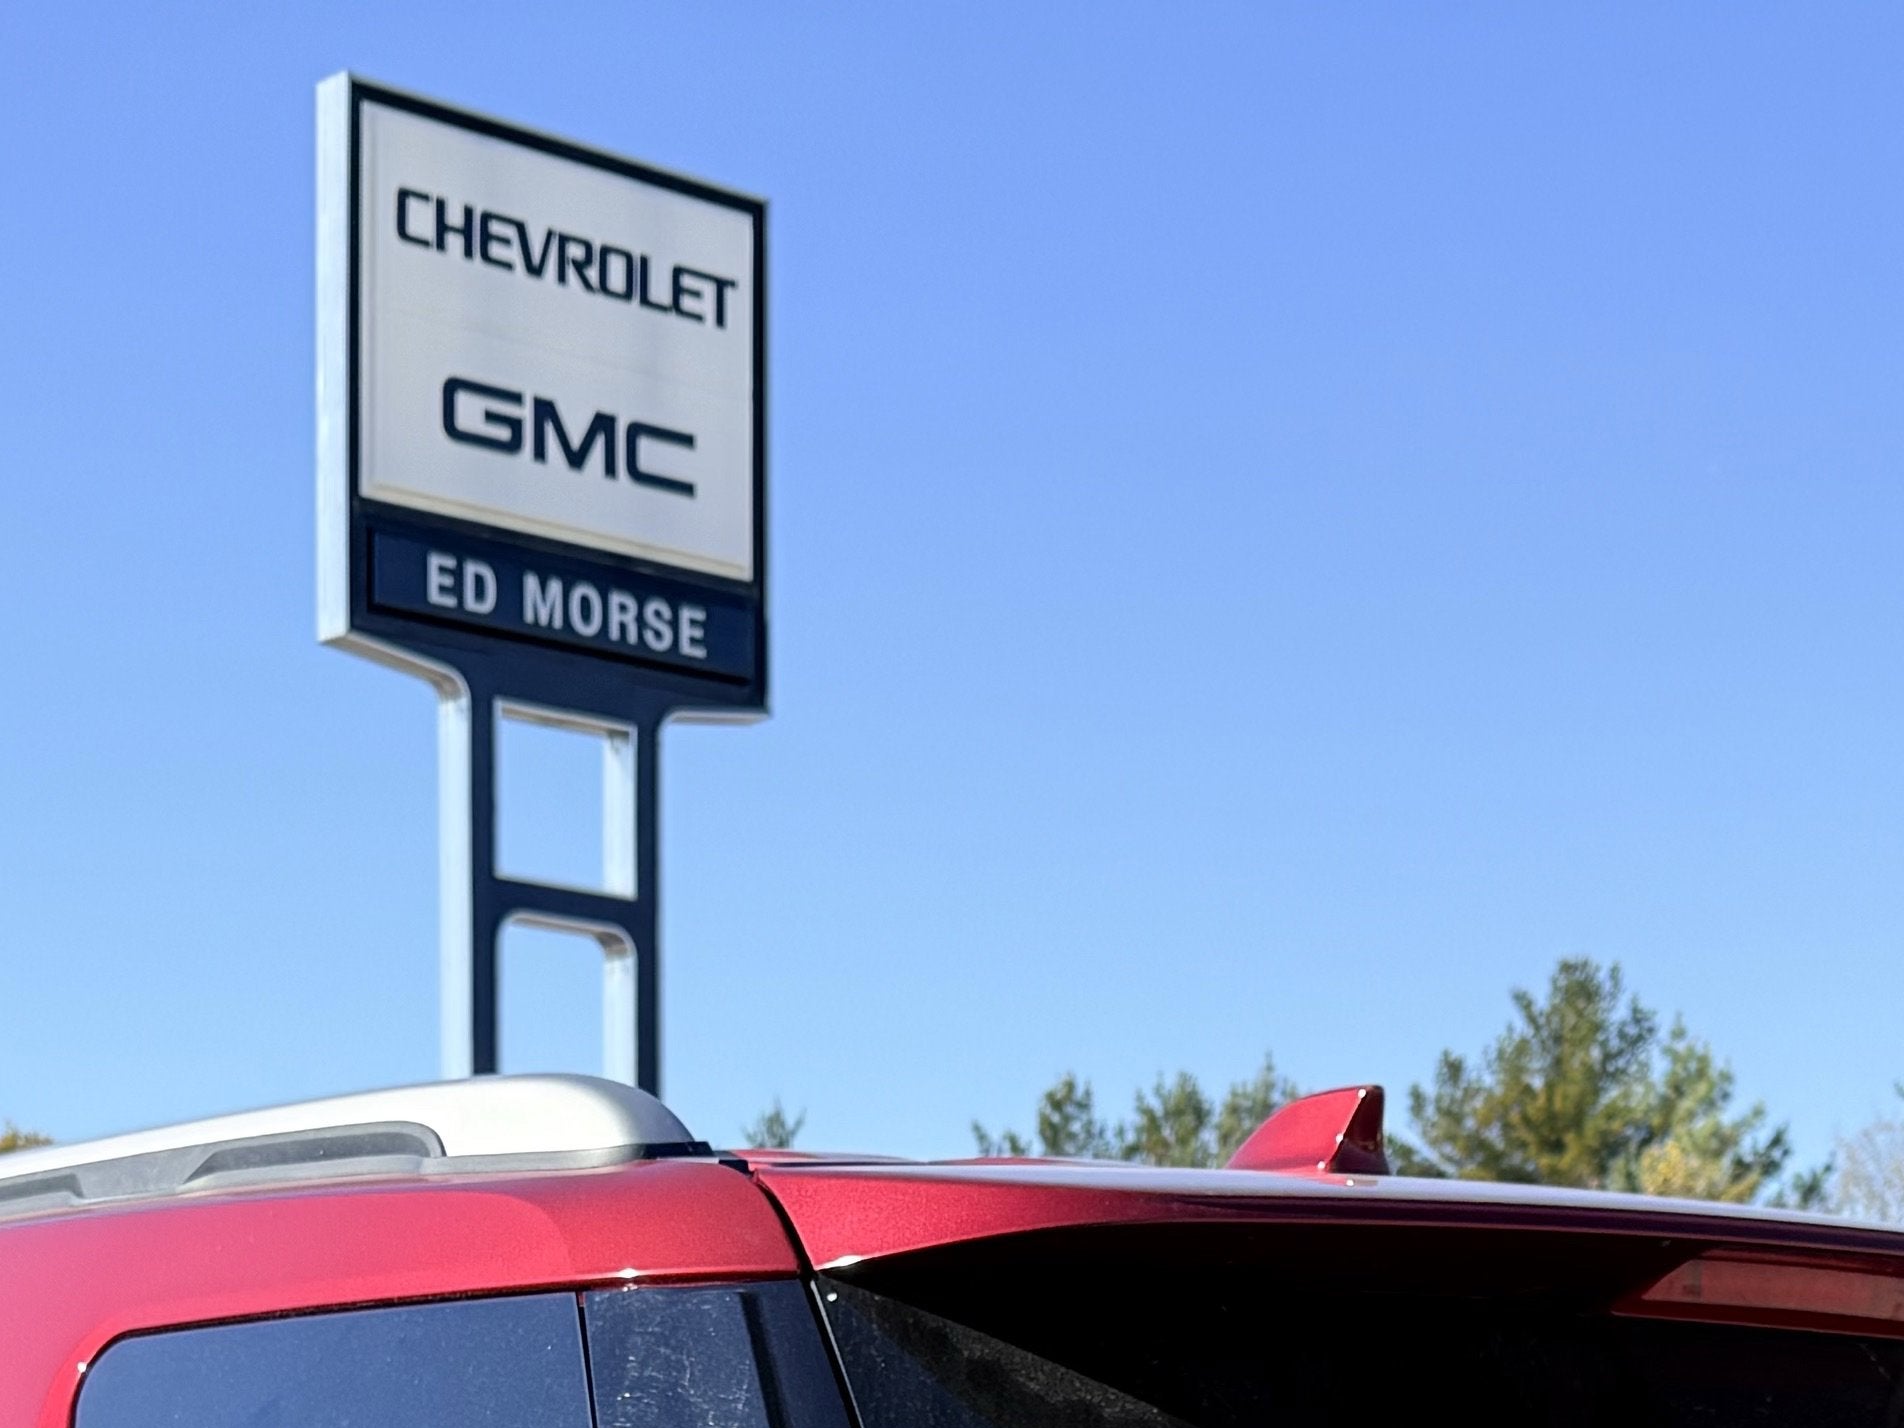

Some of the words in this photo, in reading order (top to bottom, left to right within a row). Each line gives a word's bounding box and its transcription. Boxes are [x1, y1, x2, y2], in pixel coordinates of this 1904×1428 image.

[396, 186, 738, 330] CHEVROLET
[442, 376, 695, 498] GMC
[426, 551, 498, 615] ED
[522, 569, 708, 659] MORSE
